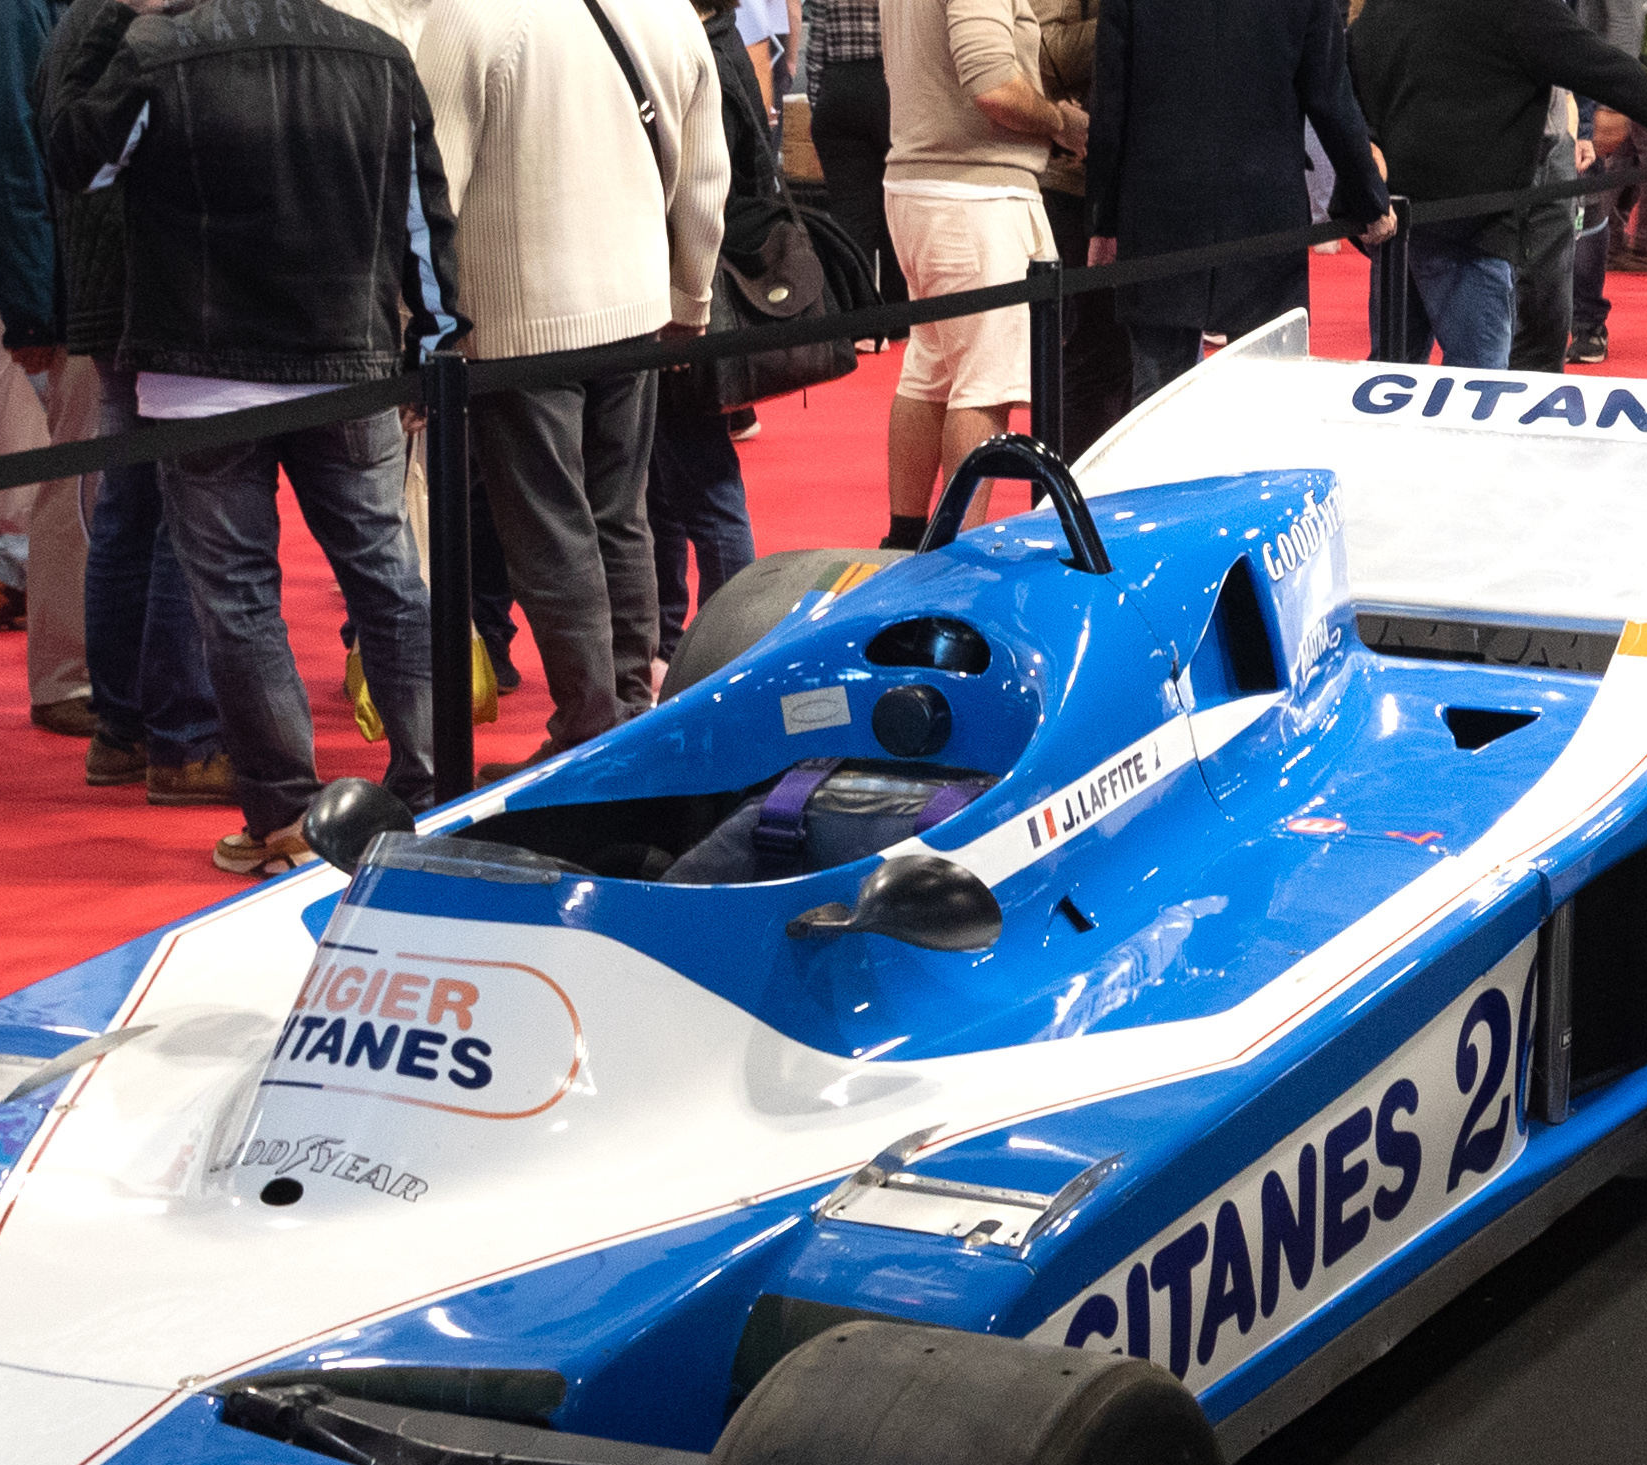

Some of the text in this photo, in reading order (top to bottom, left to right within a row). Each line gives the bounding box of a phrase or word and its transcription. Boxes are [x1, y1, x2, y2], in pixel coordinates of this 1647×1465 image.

[1062, 751, 1147, 833] J.LAFFITE
[295, 963, 480, 1031] LIGIER
[274, 1013, 493, 1090] ITANES
[1446, 985, 1537, 1197] 2
